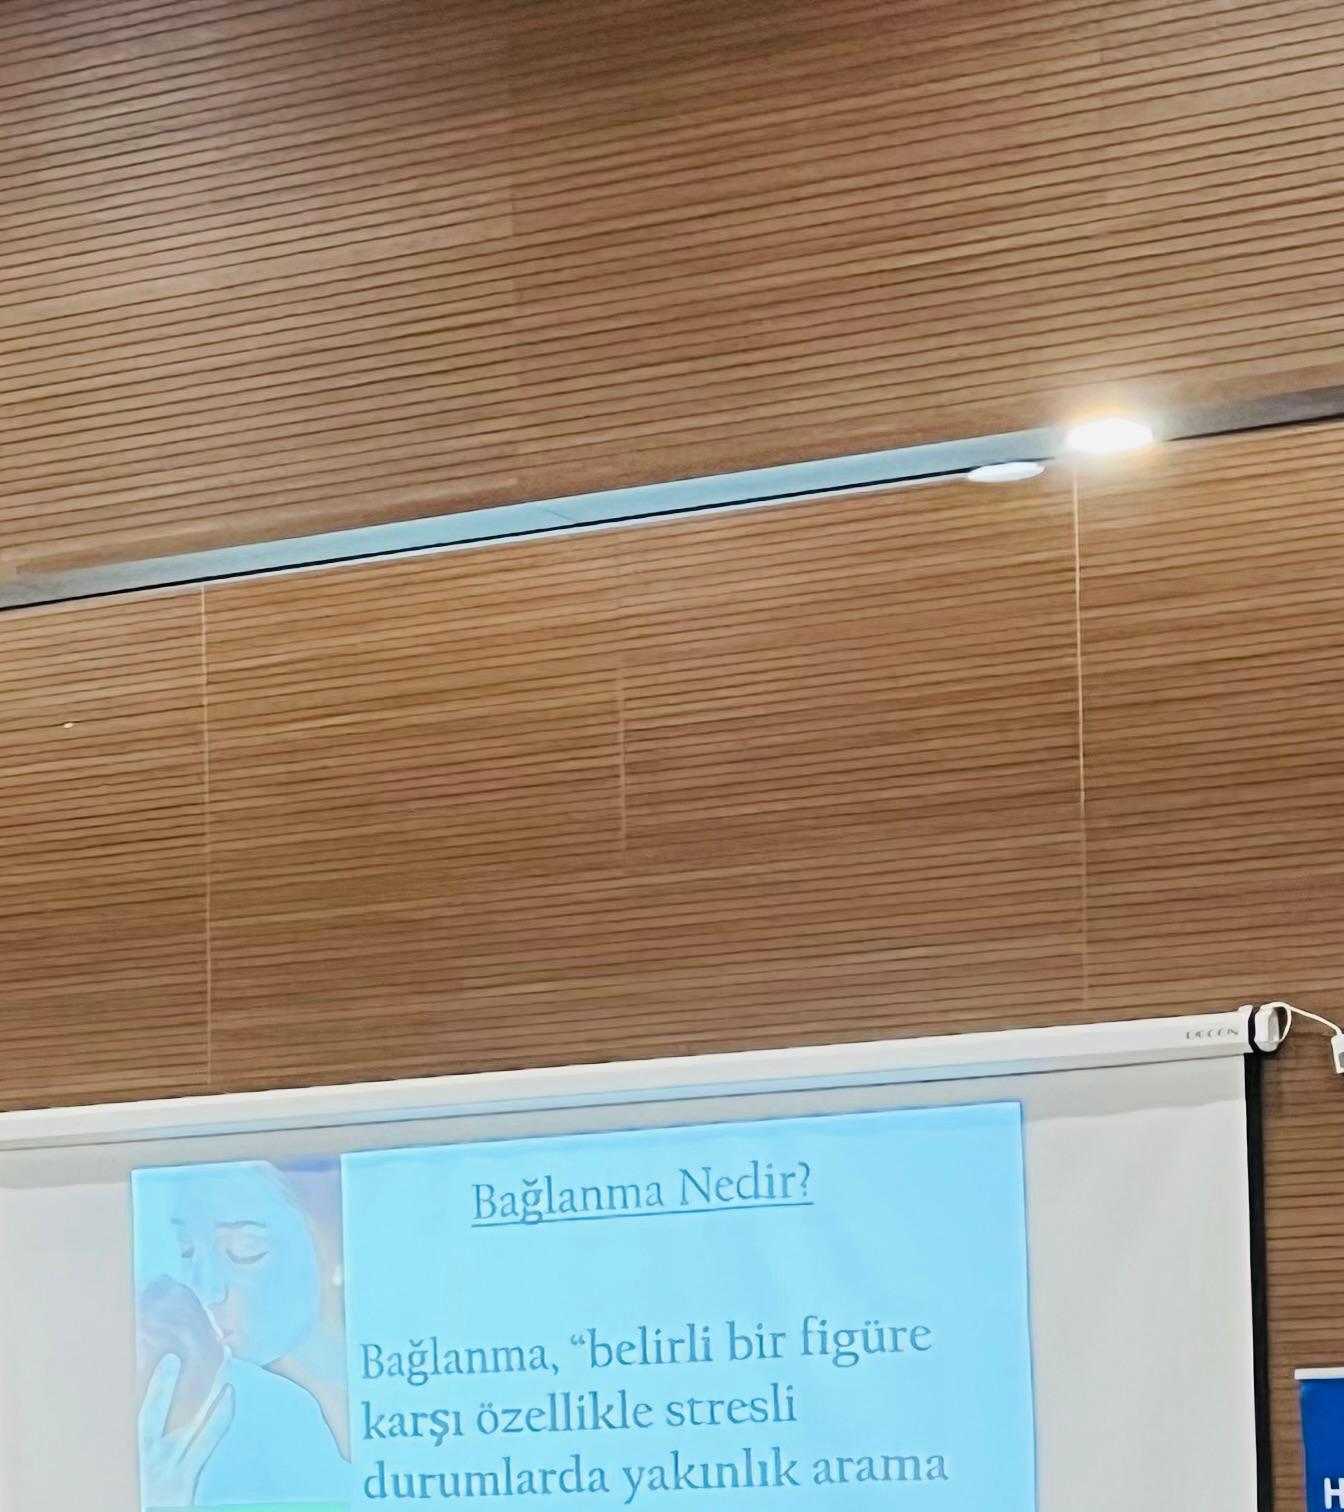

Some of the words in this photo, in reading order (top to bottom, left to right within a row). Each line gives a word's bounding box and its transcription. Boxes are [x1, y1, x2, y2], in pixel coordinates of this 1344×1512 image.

[471, 1174, 665, 1226] Bağlanma
[678, 1159, 811, 1206] Nedir?
[360, 1335, 560, 1387] Bağlanma,
[725, 1319, 787, 1362] bir
[800, 1314, 933, 1369] figüre
[361, 1399, 465, 1448] karşı
[475, 1388, 654, 1435] özellikle
[665, 1381, 798, 1427] stresli
[363, 1453, 611, 1500] durumlarda
[621, 1445, 802, 1505] yakınlık
[811, 1453, 950, 1486] arama
